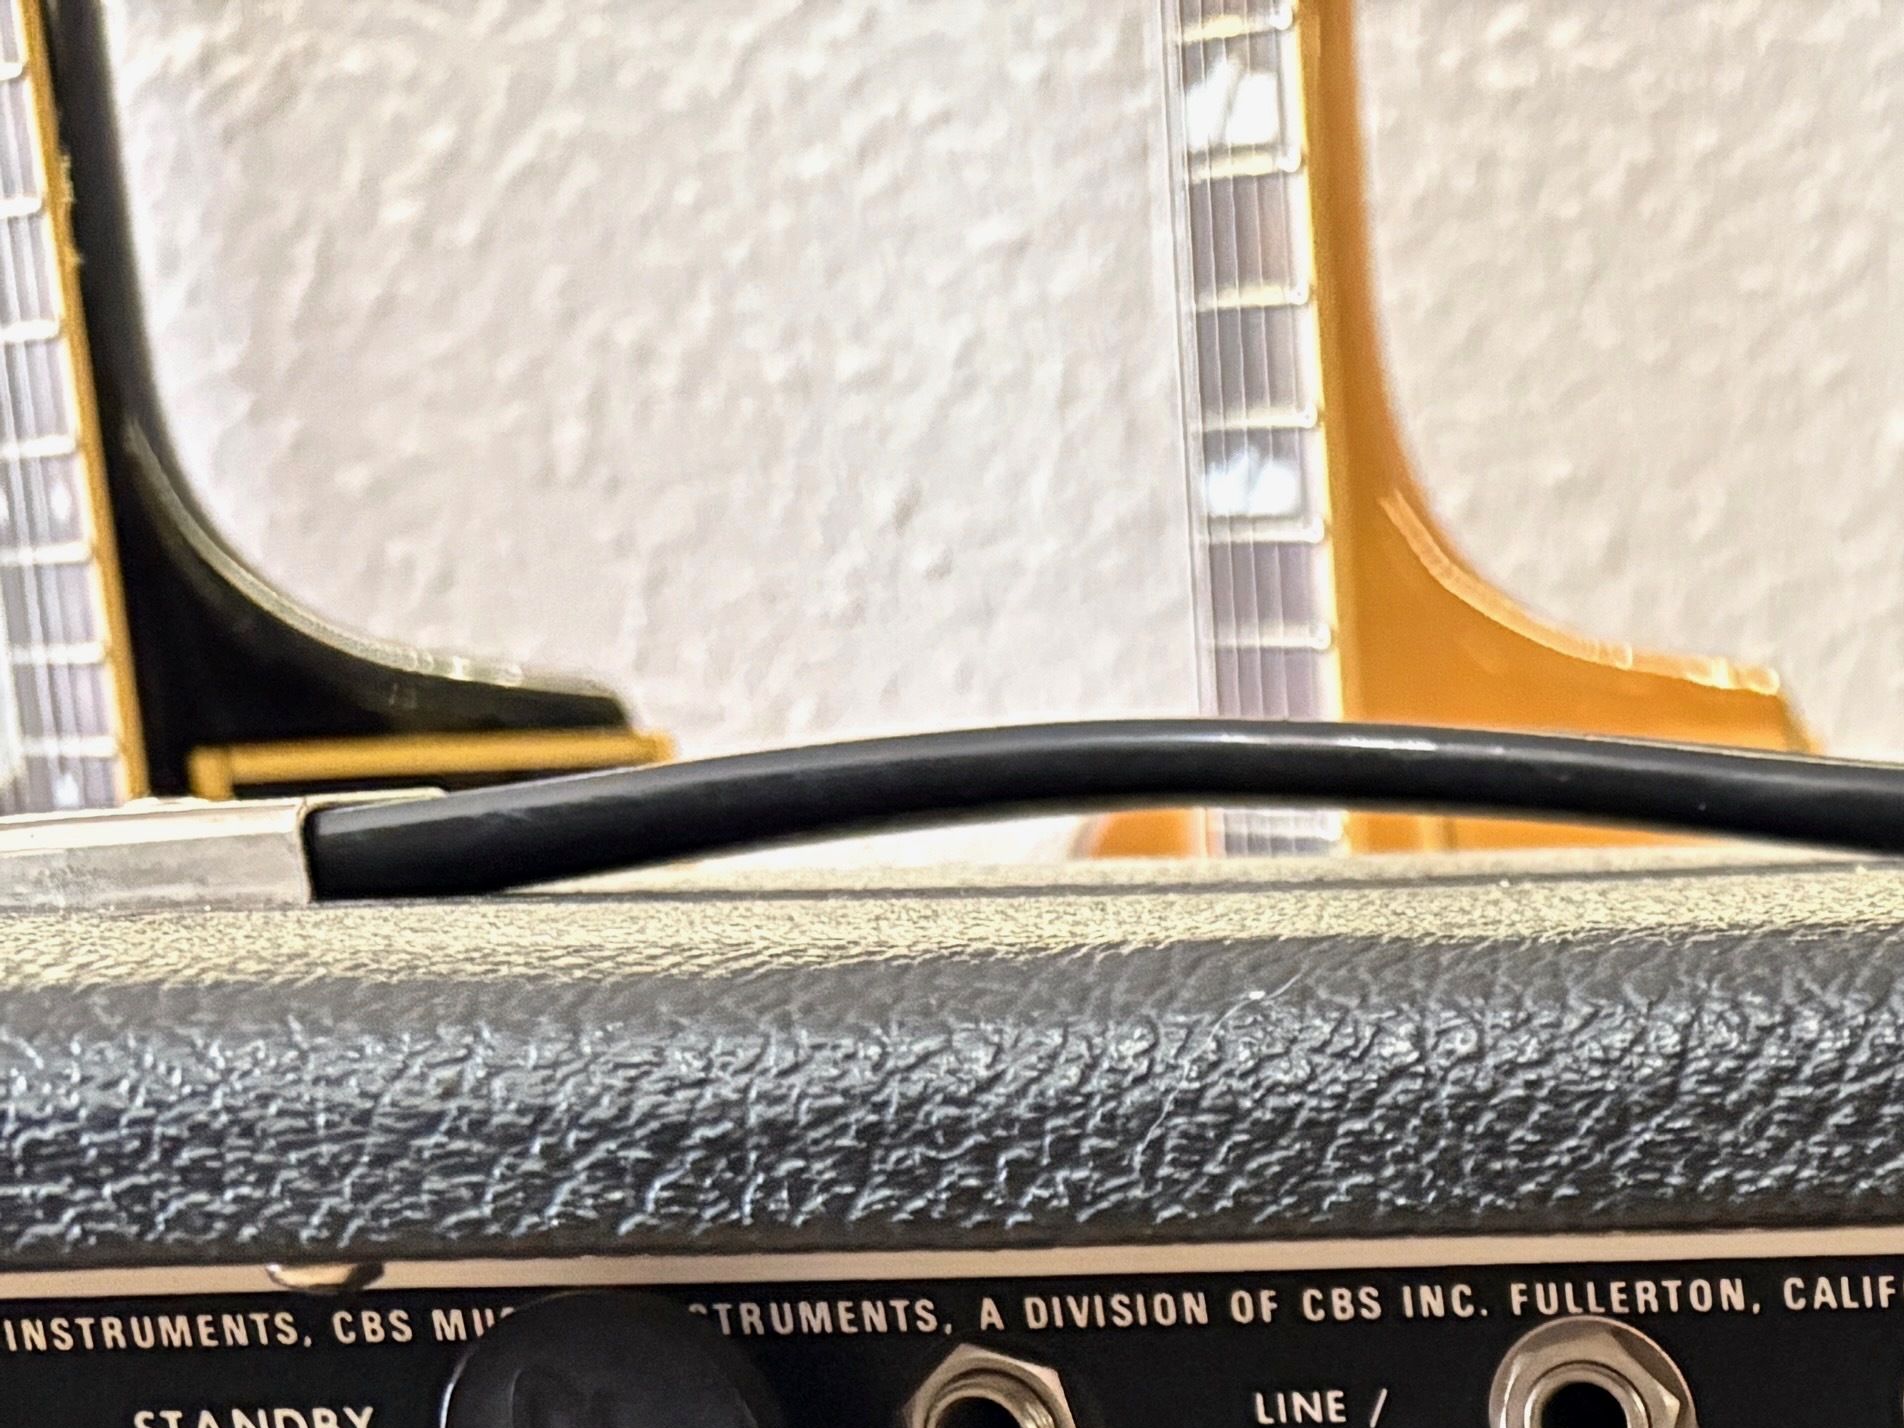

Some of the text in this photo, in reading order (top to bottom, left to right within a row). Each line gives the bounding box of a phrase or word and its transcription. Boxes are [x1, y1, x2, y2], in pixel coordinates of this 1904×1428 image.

[4, 1312, 311, 1351] INSTRUMENTS,
[333, 1310, 412, 1343] CBS
[689, 1299, 951, 1334] TRUMENTS,
[981, 1298, 1004, 1330] A
[1024, 1292, 1208, 1329] DIVISION
[1231, 1290, 1277, 1323] OF
[1303, 1287, 1381, 1321] CBS
[1403, 1284, 1487, 1317] INC.
[1511, 1279, 1760, 1315] FULLERTON,
[1256, 1390, 1346, 1424] LINE
